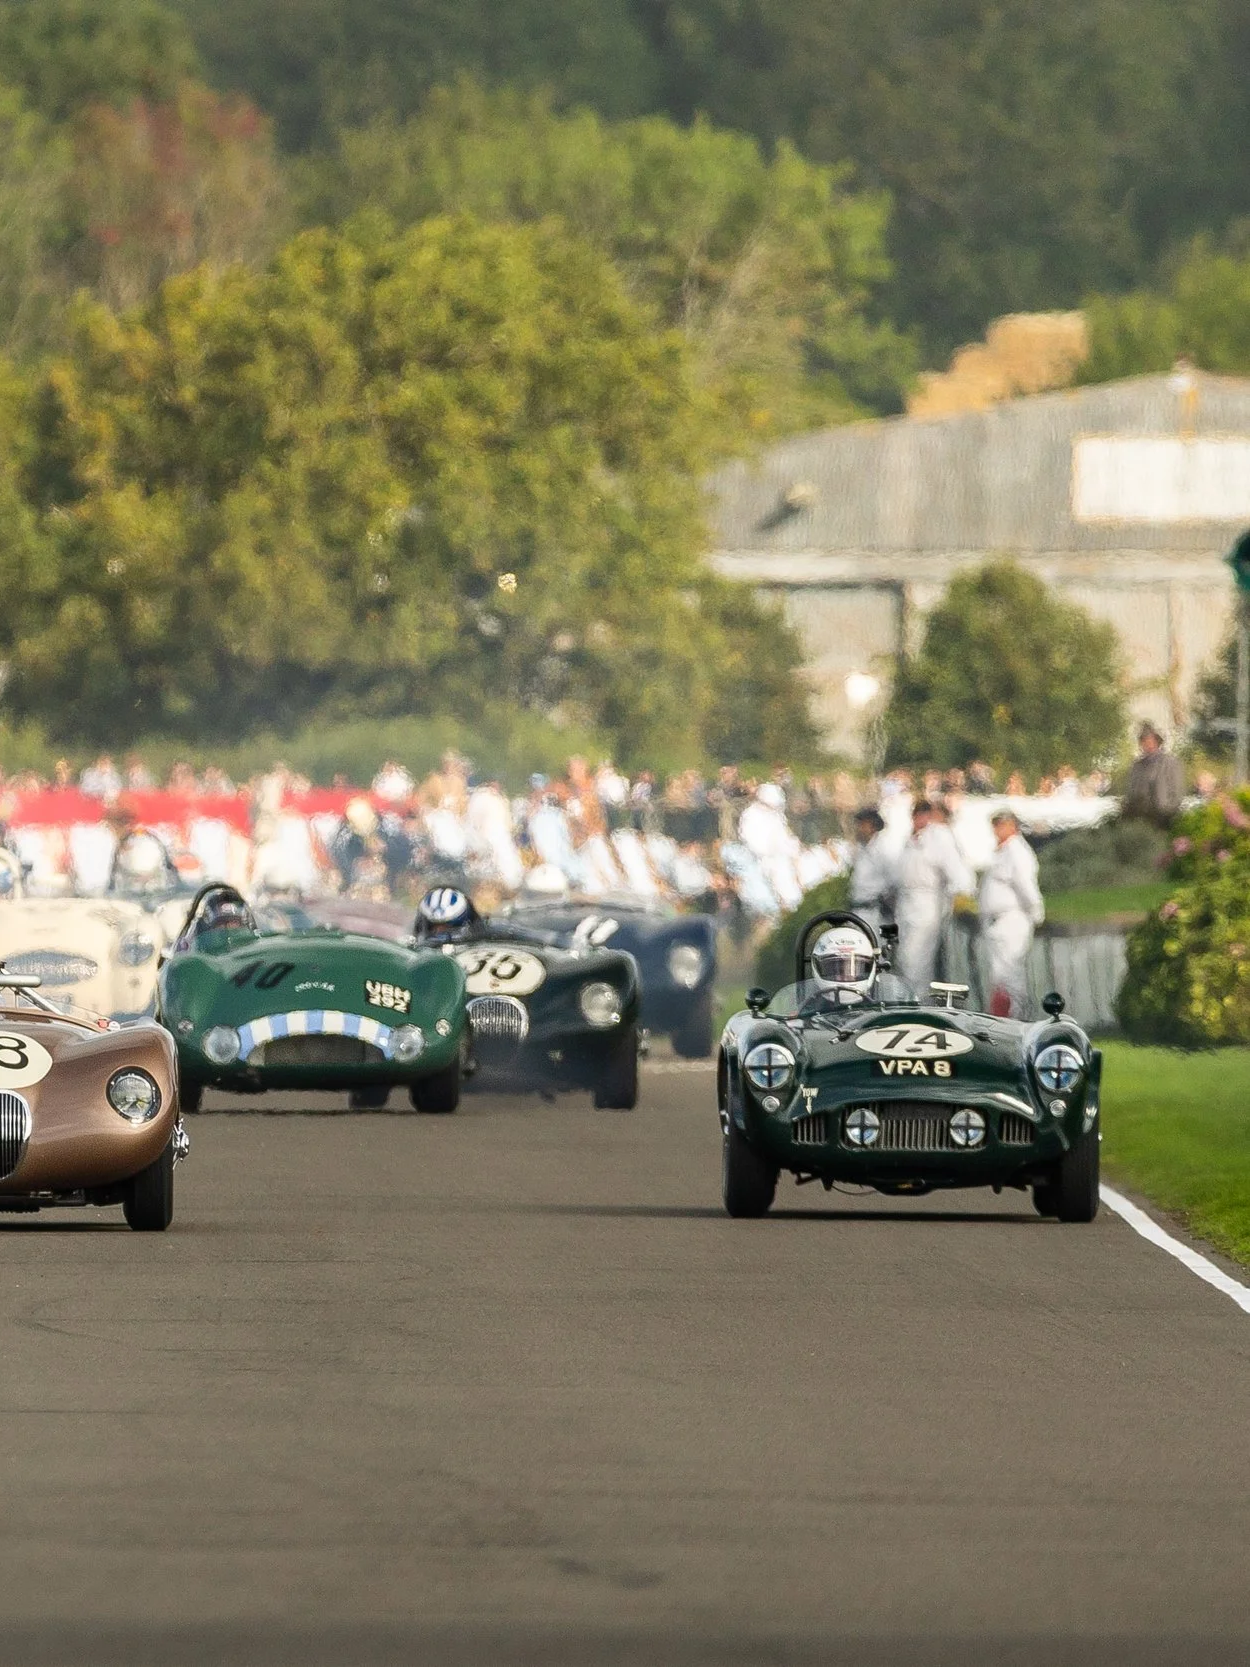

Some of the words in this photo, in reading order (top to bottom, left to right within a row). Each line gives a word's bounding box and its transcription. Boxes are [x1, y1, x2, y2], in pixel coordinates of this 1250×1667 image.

[875, 1029, 952, 1050] 74
[878, 1059, 929, 1077] VPA
[933, 1060, 952, 1078] 8
